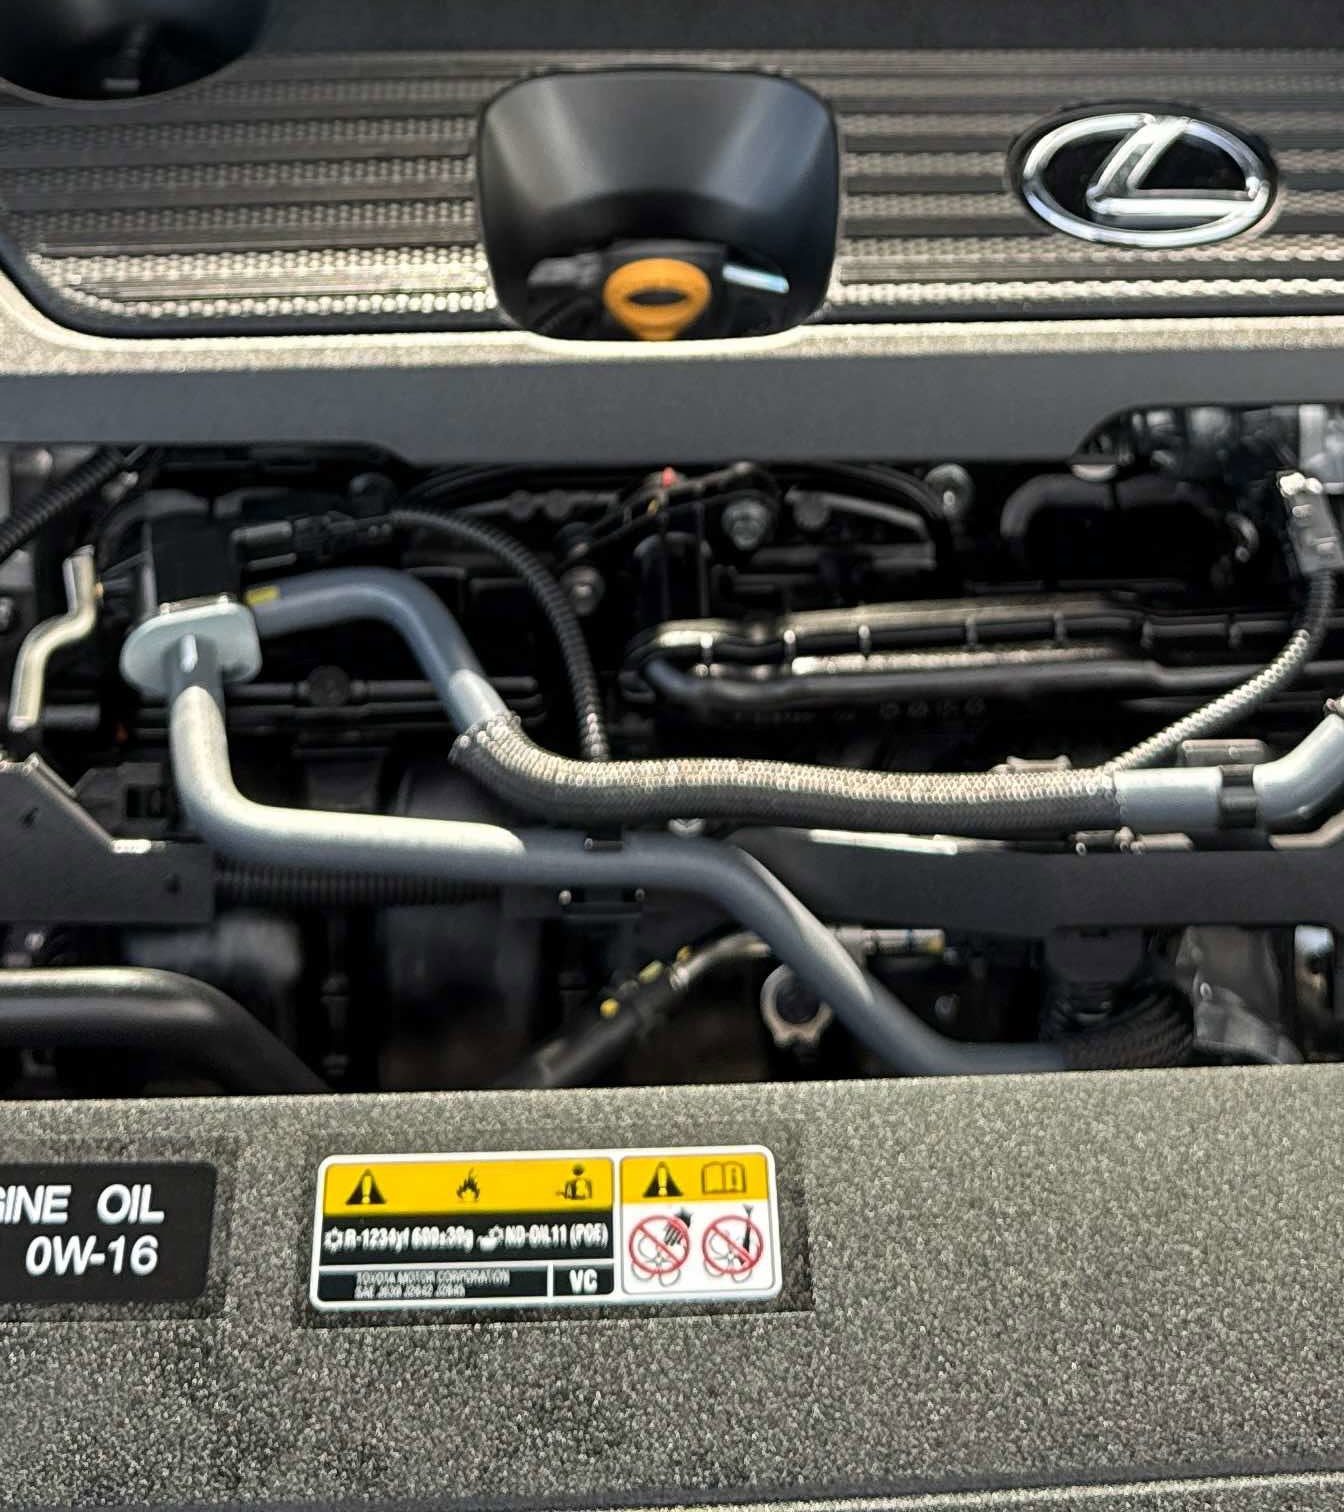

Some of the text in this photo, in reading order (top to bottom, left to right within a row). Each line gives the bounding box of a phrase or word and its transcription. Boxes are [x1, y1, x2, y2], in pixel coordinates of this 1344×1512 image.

[96, 1184, 165, 1224] OIL
[25, 1235, 159, 1276] 0W-16
[569, 1268, 598, 1294] VC
